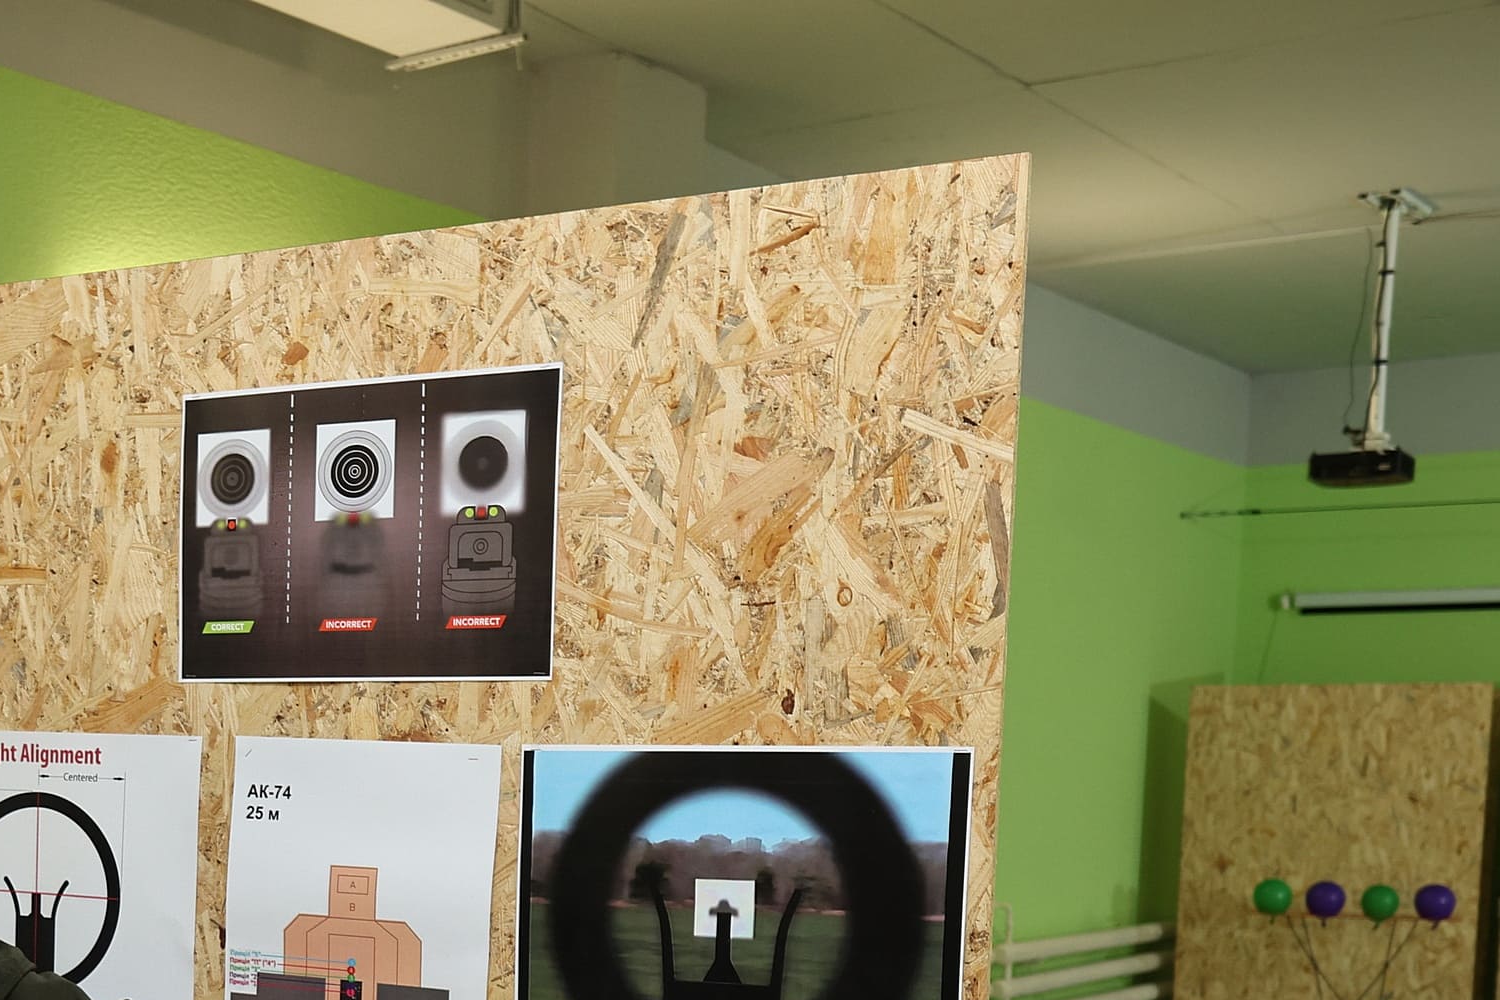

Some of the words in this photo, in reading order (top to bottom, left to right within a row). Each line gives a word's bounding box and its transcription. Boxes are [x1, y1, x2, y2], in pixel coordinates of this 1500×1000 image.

[325, 619, 373, 629] INCORRECT
[452, 616, 501, 626] INCORRECT
[210, 622, 245, 632] CORRECT
[20, 743, 102, 768] Alignment
[63, 772, 98, 783] Centered
[246, 805, 264, 820] 25
[350, 881, 357, 889] A
[349, 902, 356, 911] B
